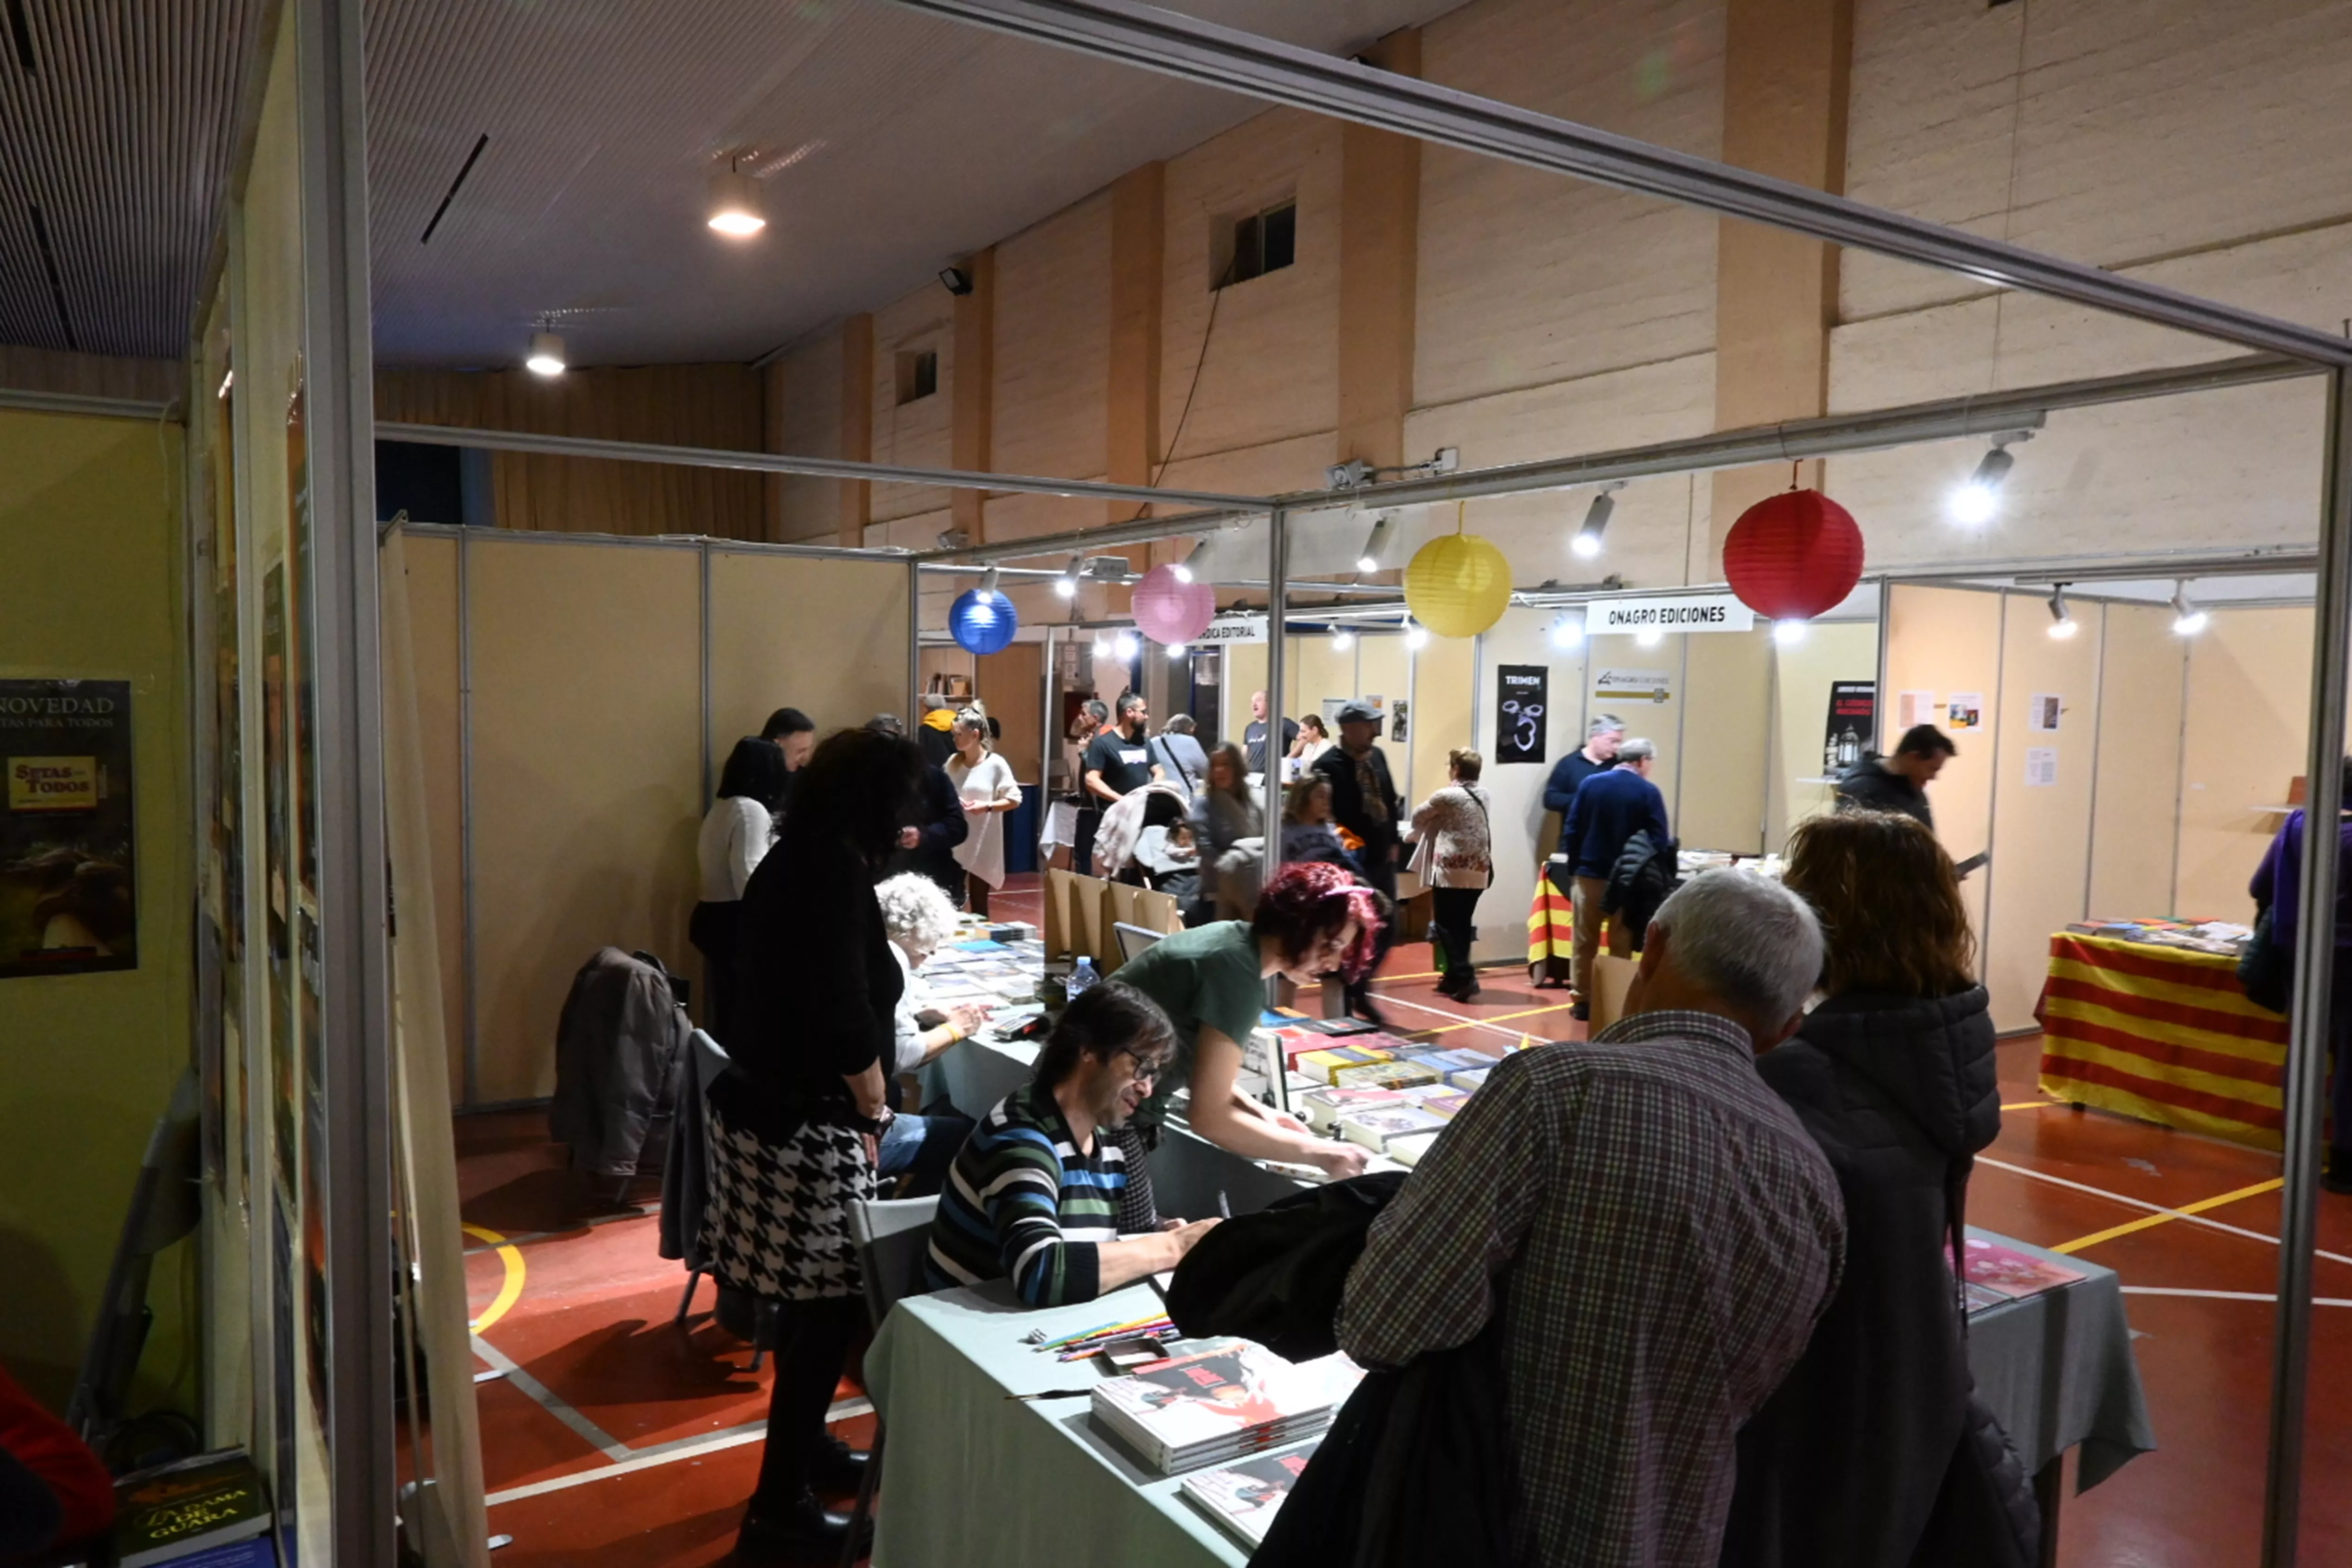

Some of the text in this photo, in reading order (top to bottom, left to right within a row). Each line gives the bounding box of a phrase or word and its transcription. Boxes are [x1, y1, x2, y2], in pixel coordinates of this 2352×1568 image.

[1609, 606, 1725, 625] ONAGRO EDICIONES
[1222, 625, 1256, 638] EDITORIAL
[1505, 675, 1541, 685] TRIMEN
[27, 718, 65, 728] PARA
[66, 718, 114, 728] TODOS
[25, 779, 90, 793] TODOS
[149, 1508, 238, 1538] GUARA
